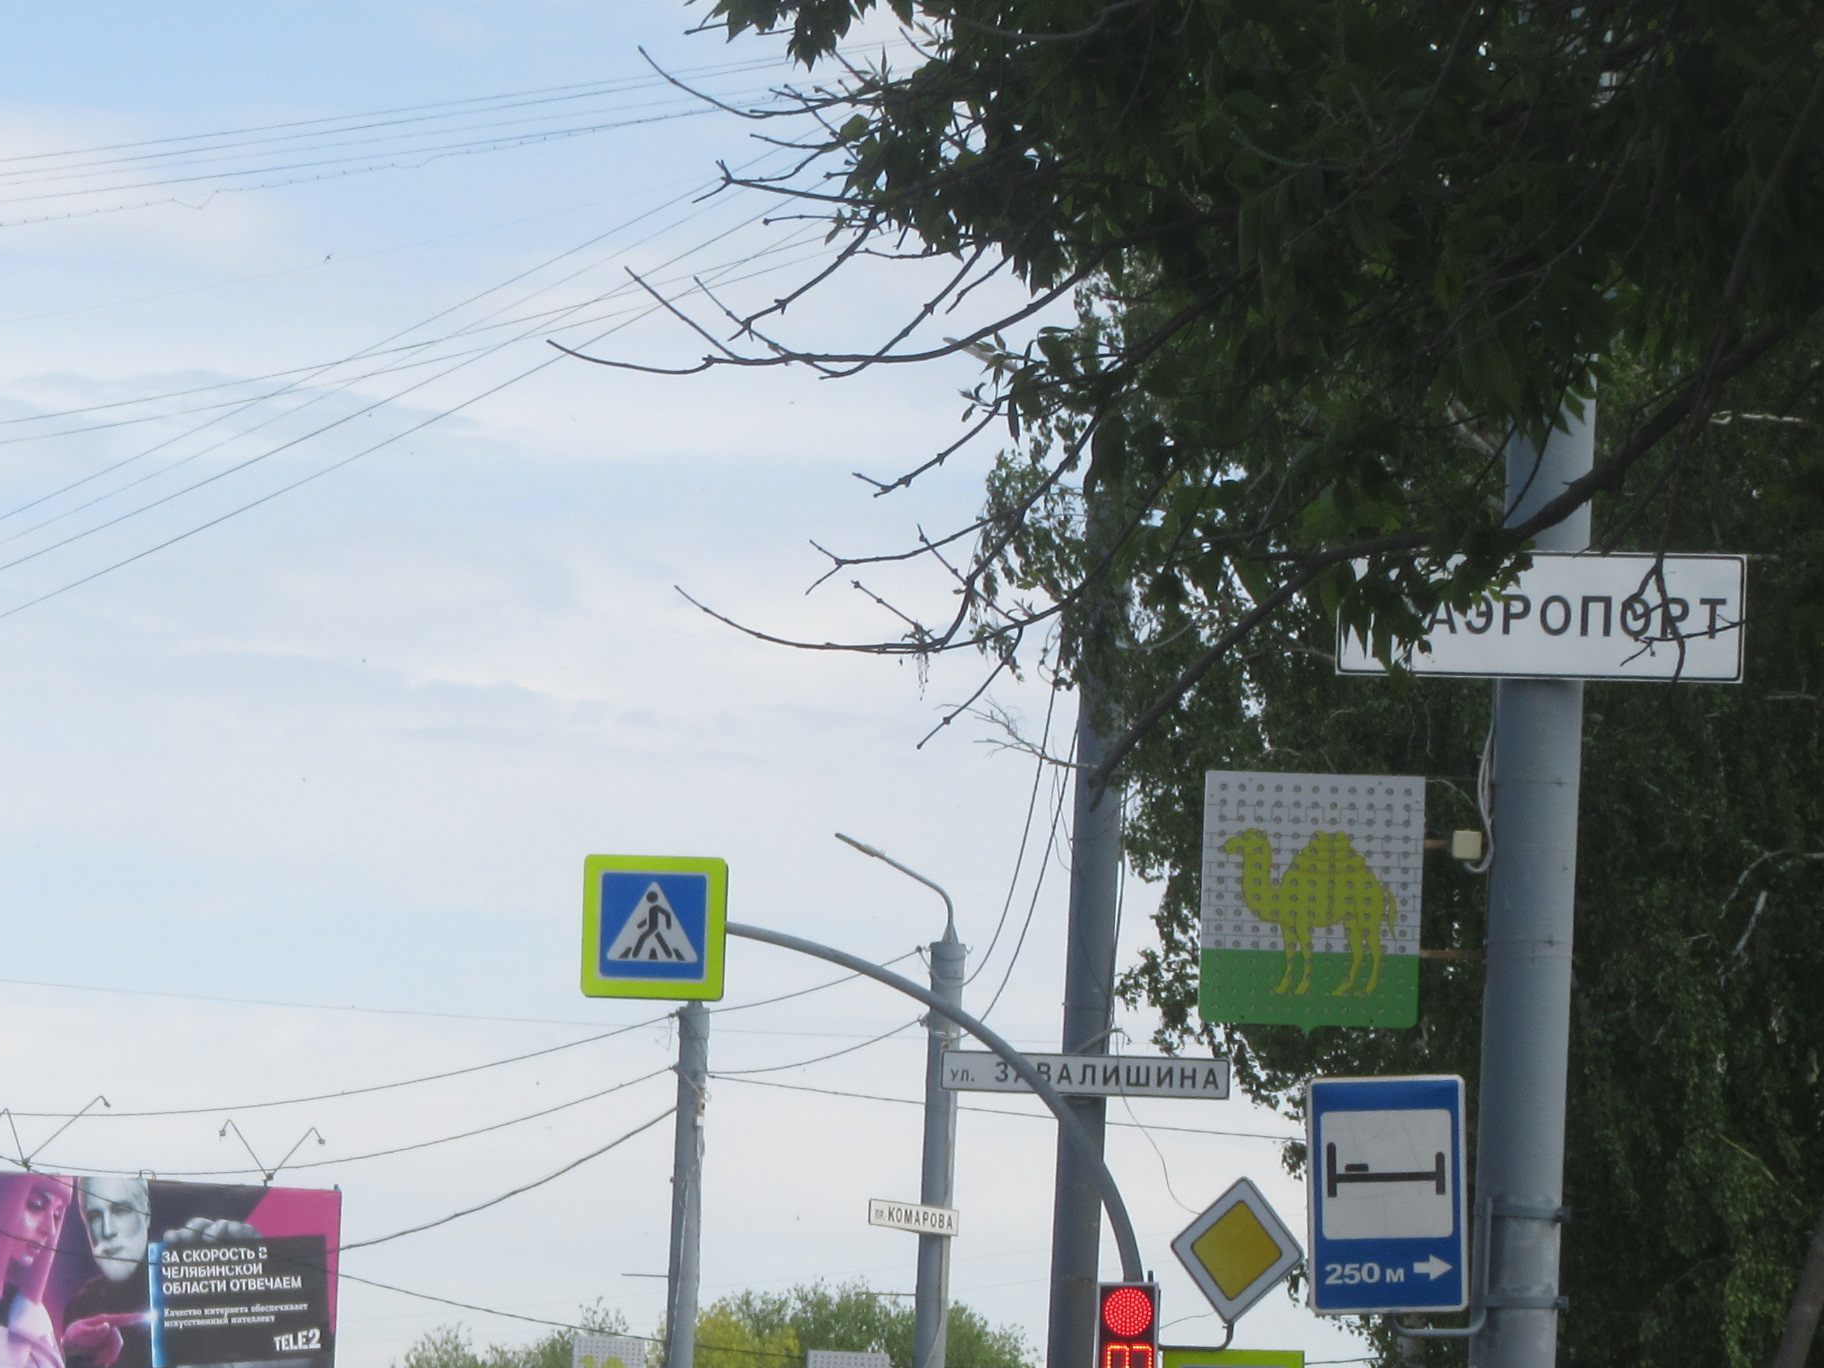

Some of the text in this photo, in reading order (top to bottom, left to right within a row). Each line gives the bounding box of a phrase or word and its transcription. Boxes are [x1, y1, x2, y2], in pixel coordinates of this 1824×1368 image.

[951, 1068, 975, 1083] ул.
[888, 1206, 953, 1230] КОМАРОВА
[162, 1250, 180, 1264] ЗА
[182, 1247, 256, 1263] СКОРОСТЬ
[1325, 1263, 1381, 1284] 250
[162, 1276, 302, 1295] ОБЛАСТИ ОТВЕЧАЕМ
[273, 1328, 321, 1351] TELE2
